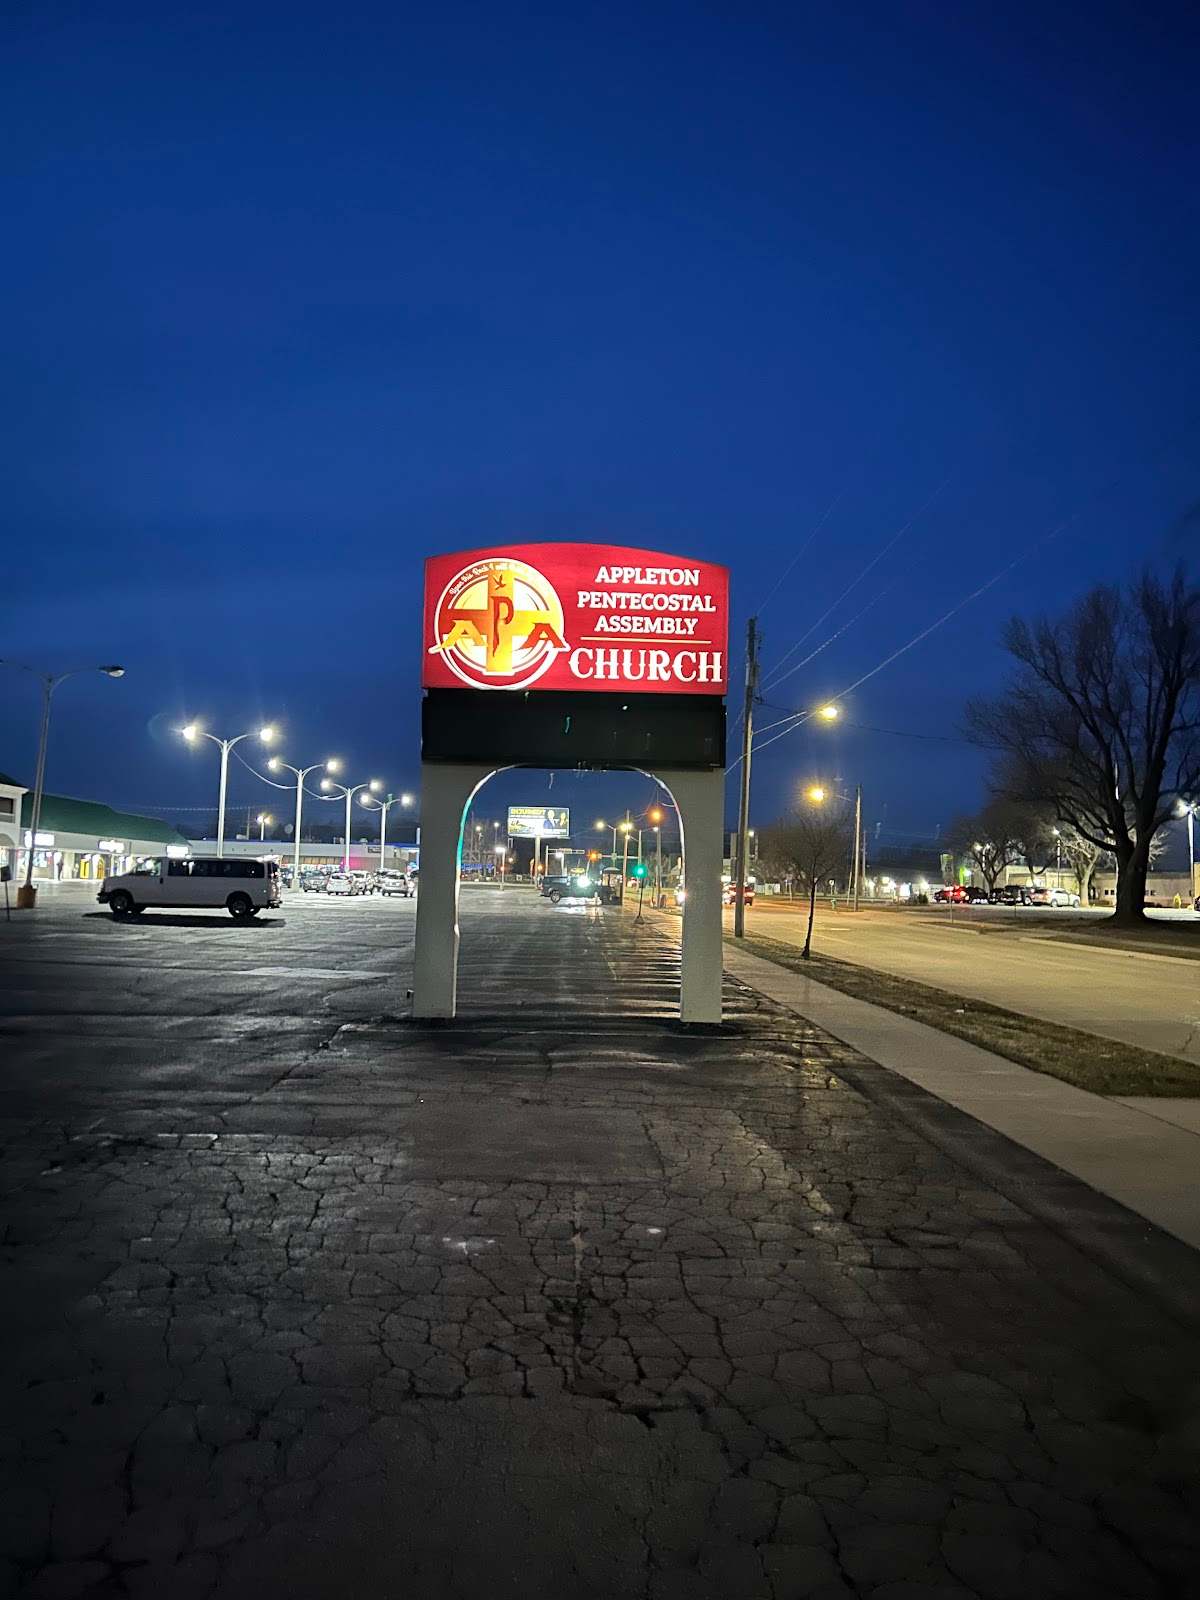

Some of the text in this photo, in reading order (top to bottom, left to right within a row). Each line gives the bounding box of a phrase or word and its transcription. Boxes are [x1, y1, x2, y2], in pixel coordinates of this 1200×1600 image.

[595, 566, 700, 586] APPLETON
[577, 591, 716, 613] PENTECOSTAL
[594, 615, 699, 636] ASSEMBLY
[568, 647, 723, 683] CHURCH
